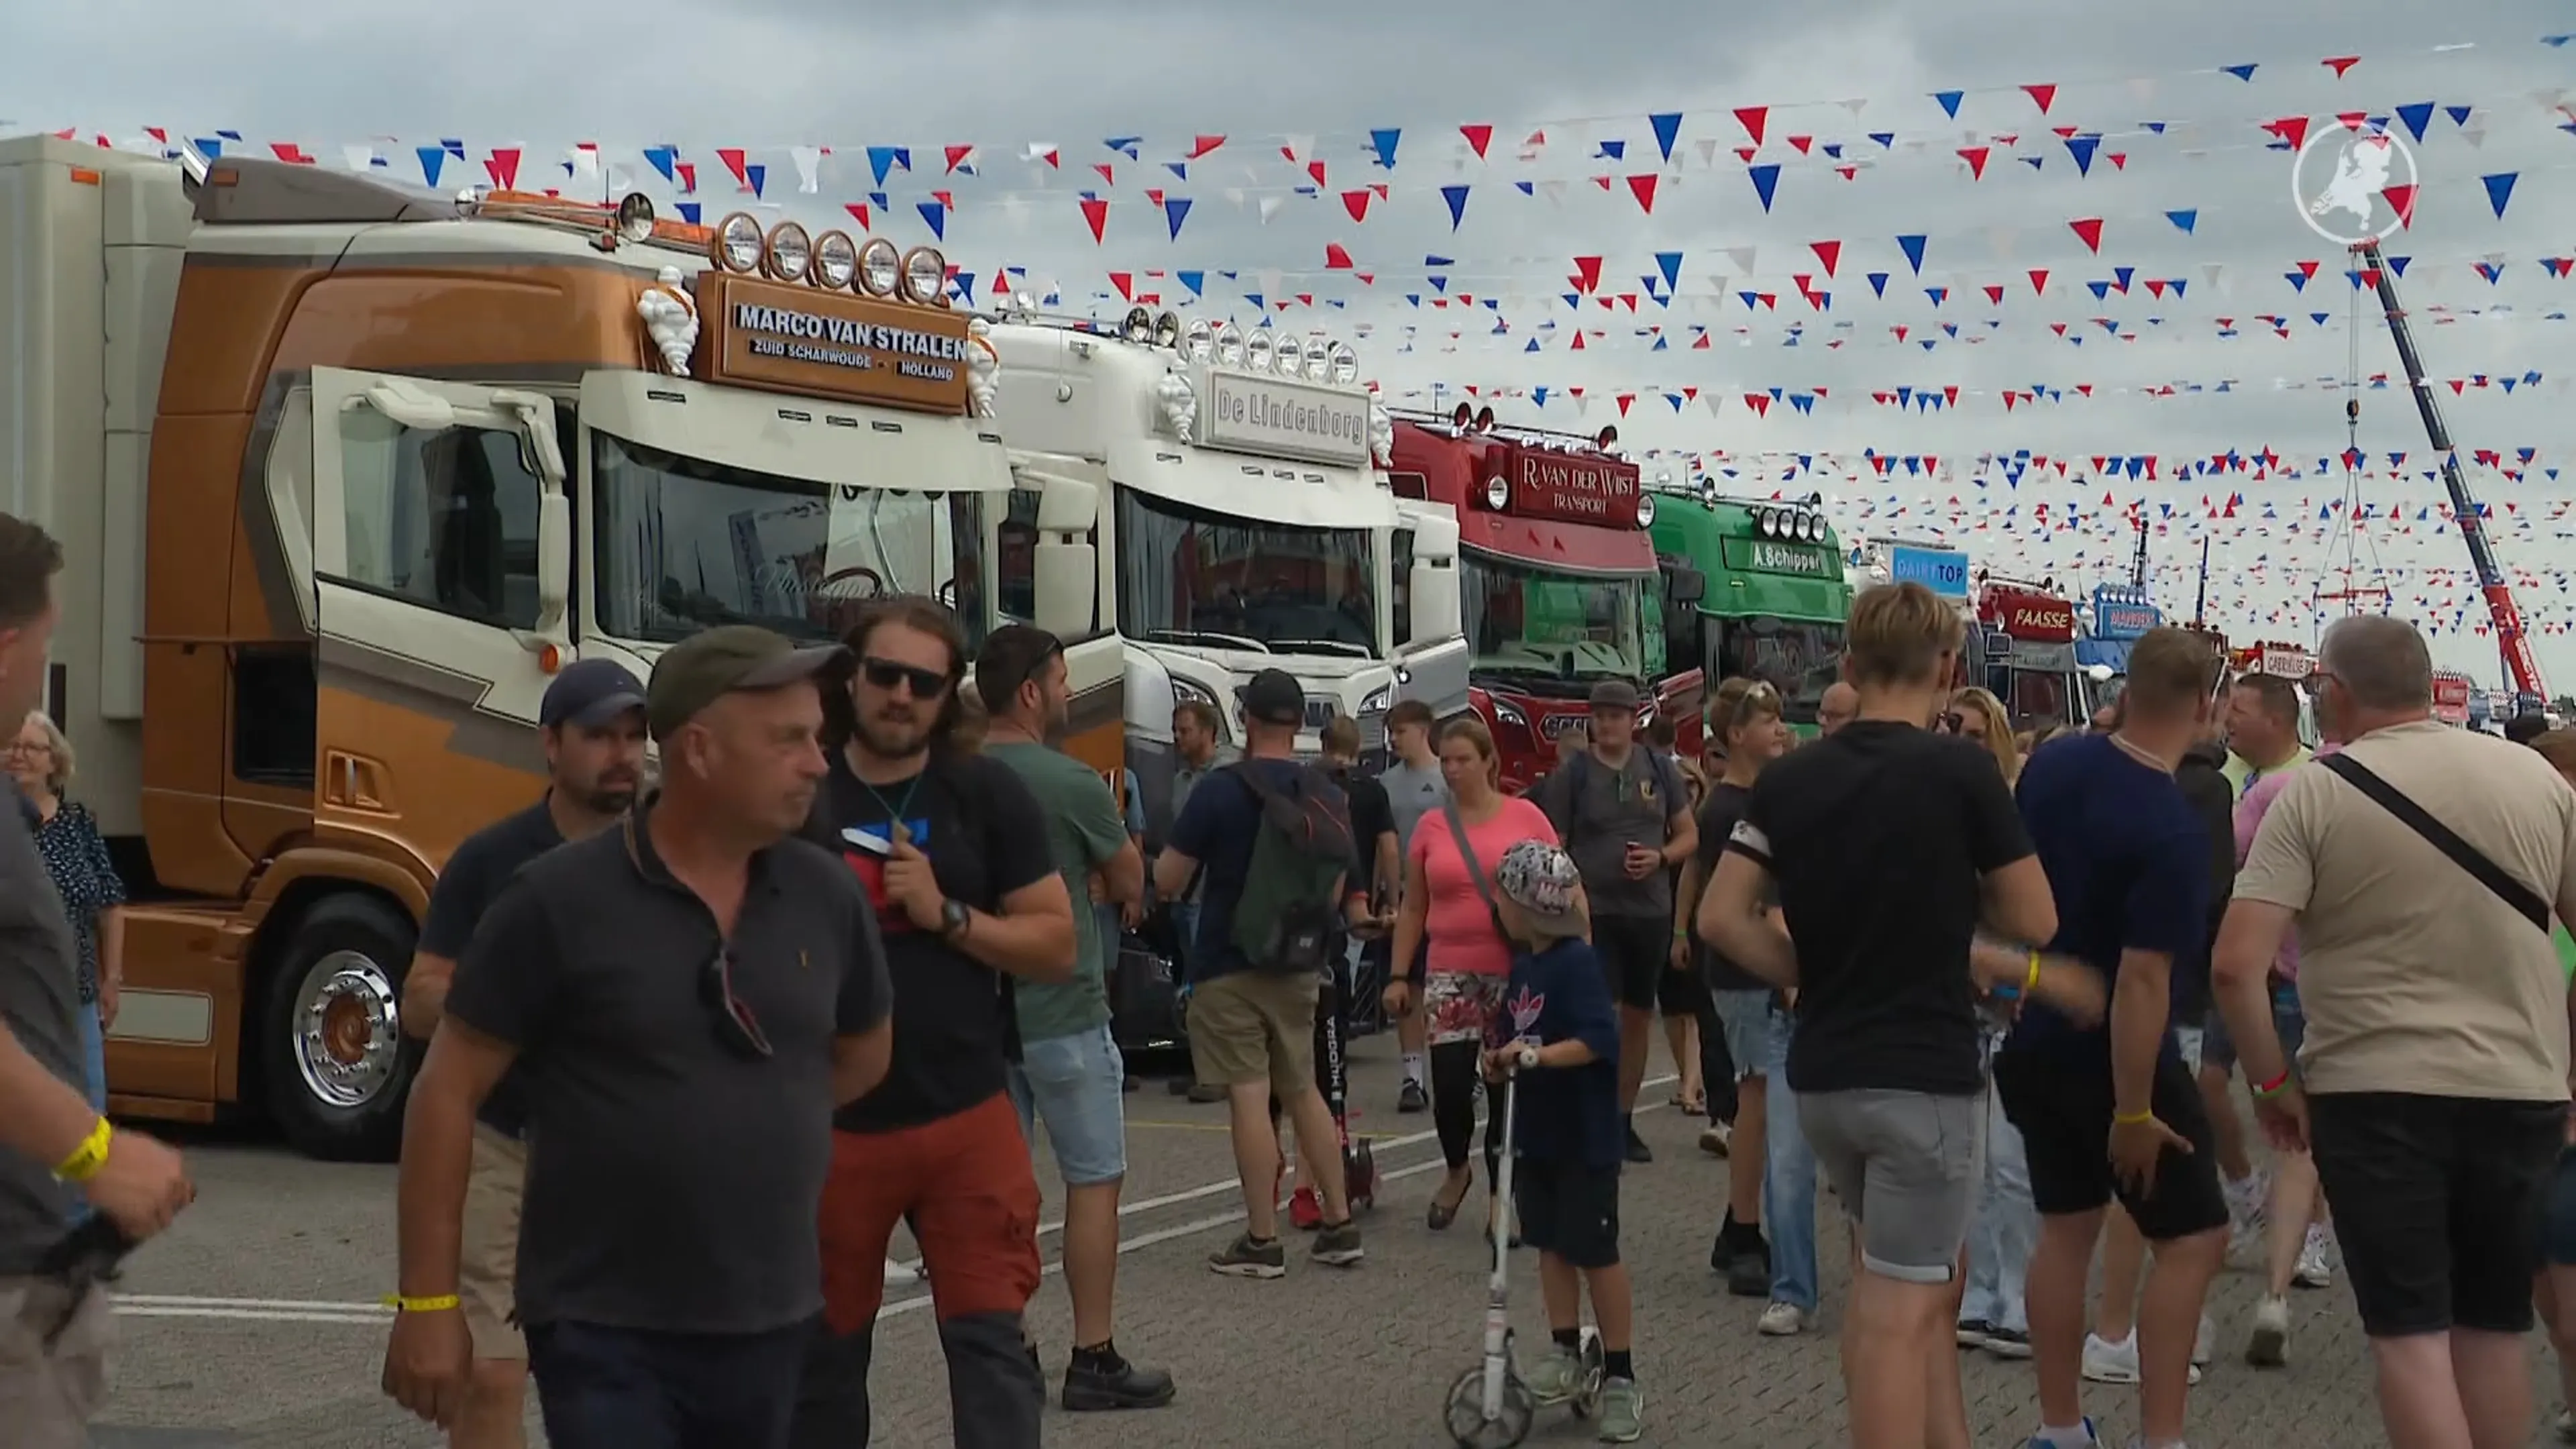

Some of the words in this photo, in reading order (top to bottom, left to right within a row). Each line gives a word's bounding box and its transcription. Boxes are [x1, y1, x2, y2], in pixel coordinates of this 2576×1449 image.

[736, 304, 822, 339] MARCO
[826, 320, 872, 347] VAN
[875, 327, 967, 362] STRALEN
[750, 340, 784, 357] ZUID
[788, 345, 871, 369] SCHARWOUDE
[898, 362, 954, 381] HOLLAND
[1219, 391, 1244, 423] De
[1250, 395, 1363, 443] Lindenborg
[1542, 464, 1568, 486] VAN
[1572, 468, 1597, 491] DER
[1554, 493, 1607, 515] TRANSPORT
[2014, 608, 2069, 629] FAASSE
